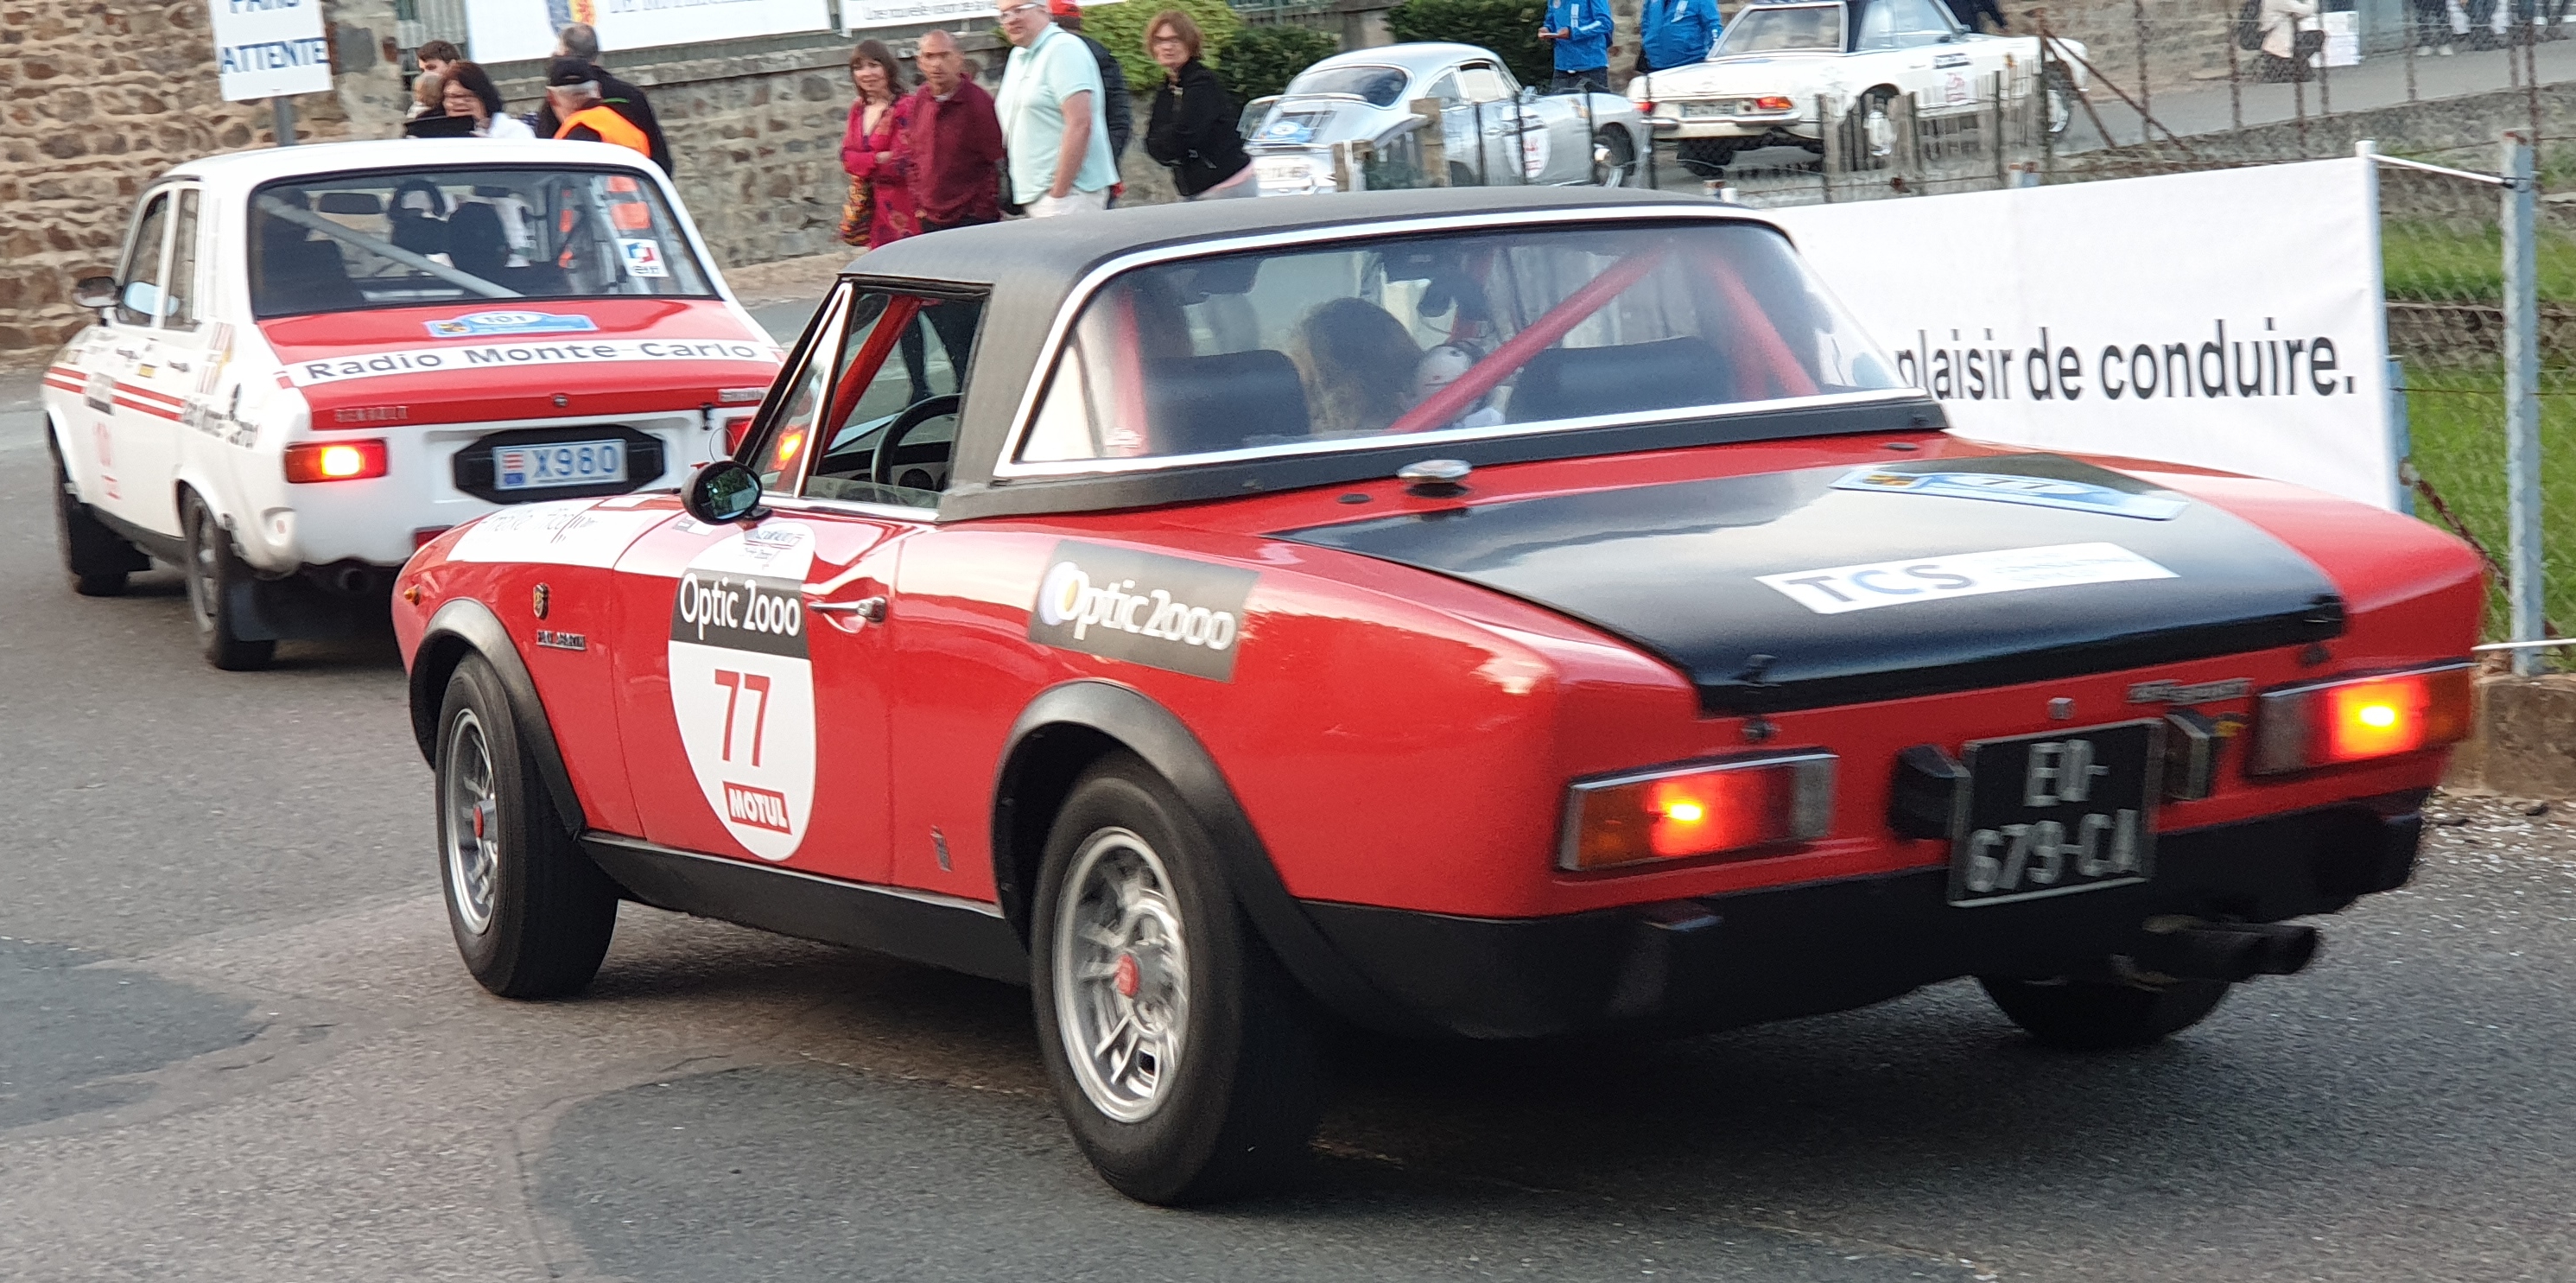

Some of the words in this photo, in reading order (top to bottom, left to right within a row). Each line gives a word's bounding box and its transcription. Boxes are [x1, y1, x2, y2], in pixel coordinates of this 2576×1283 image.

[221, 37, 331, 74] ATTENTE
[482, 314, 528, 324] 101
[305, 353, 443, 379] Radio
[462, 342, 758, 365] Monte-Carlo
[2026, 327, 2085, 401] de
[2098, 317, 2358, 400] conduire.
[532, 445, 619, 478] X980
[1783, 563, 1977, 603] TCS
[680, 572, 739, 641] Optic
[742, 579, 801, 637] 2000
[714, 668, 771, 768] 77
[728, 787, 790, 829] MOTUL
